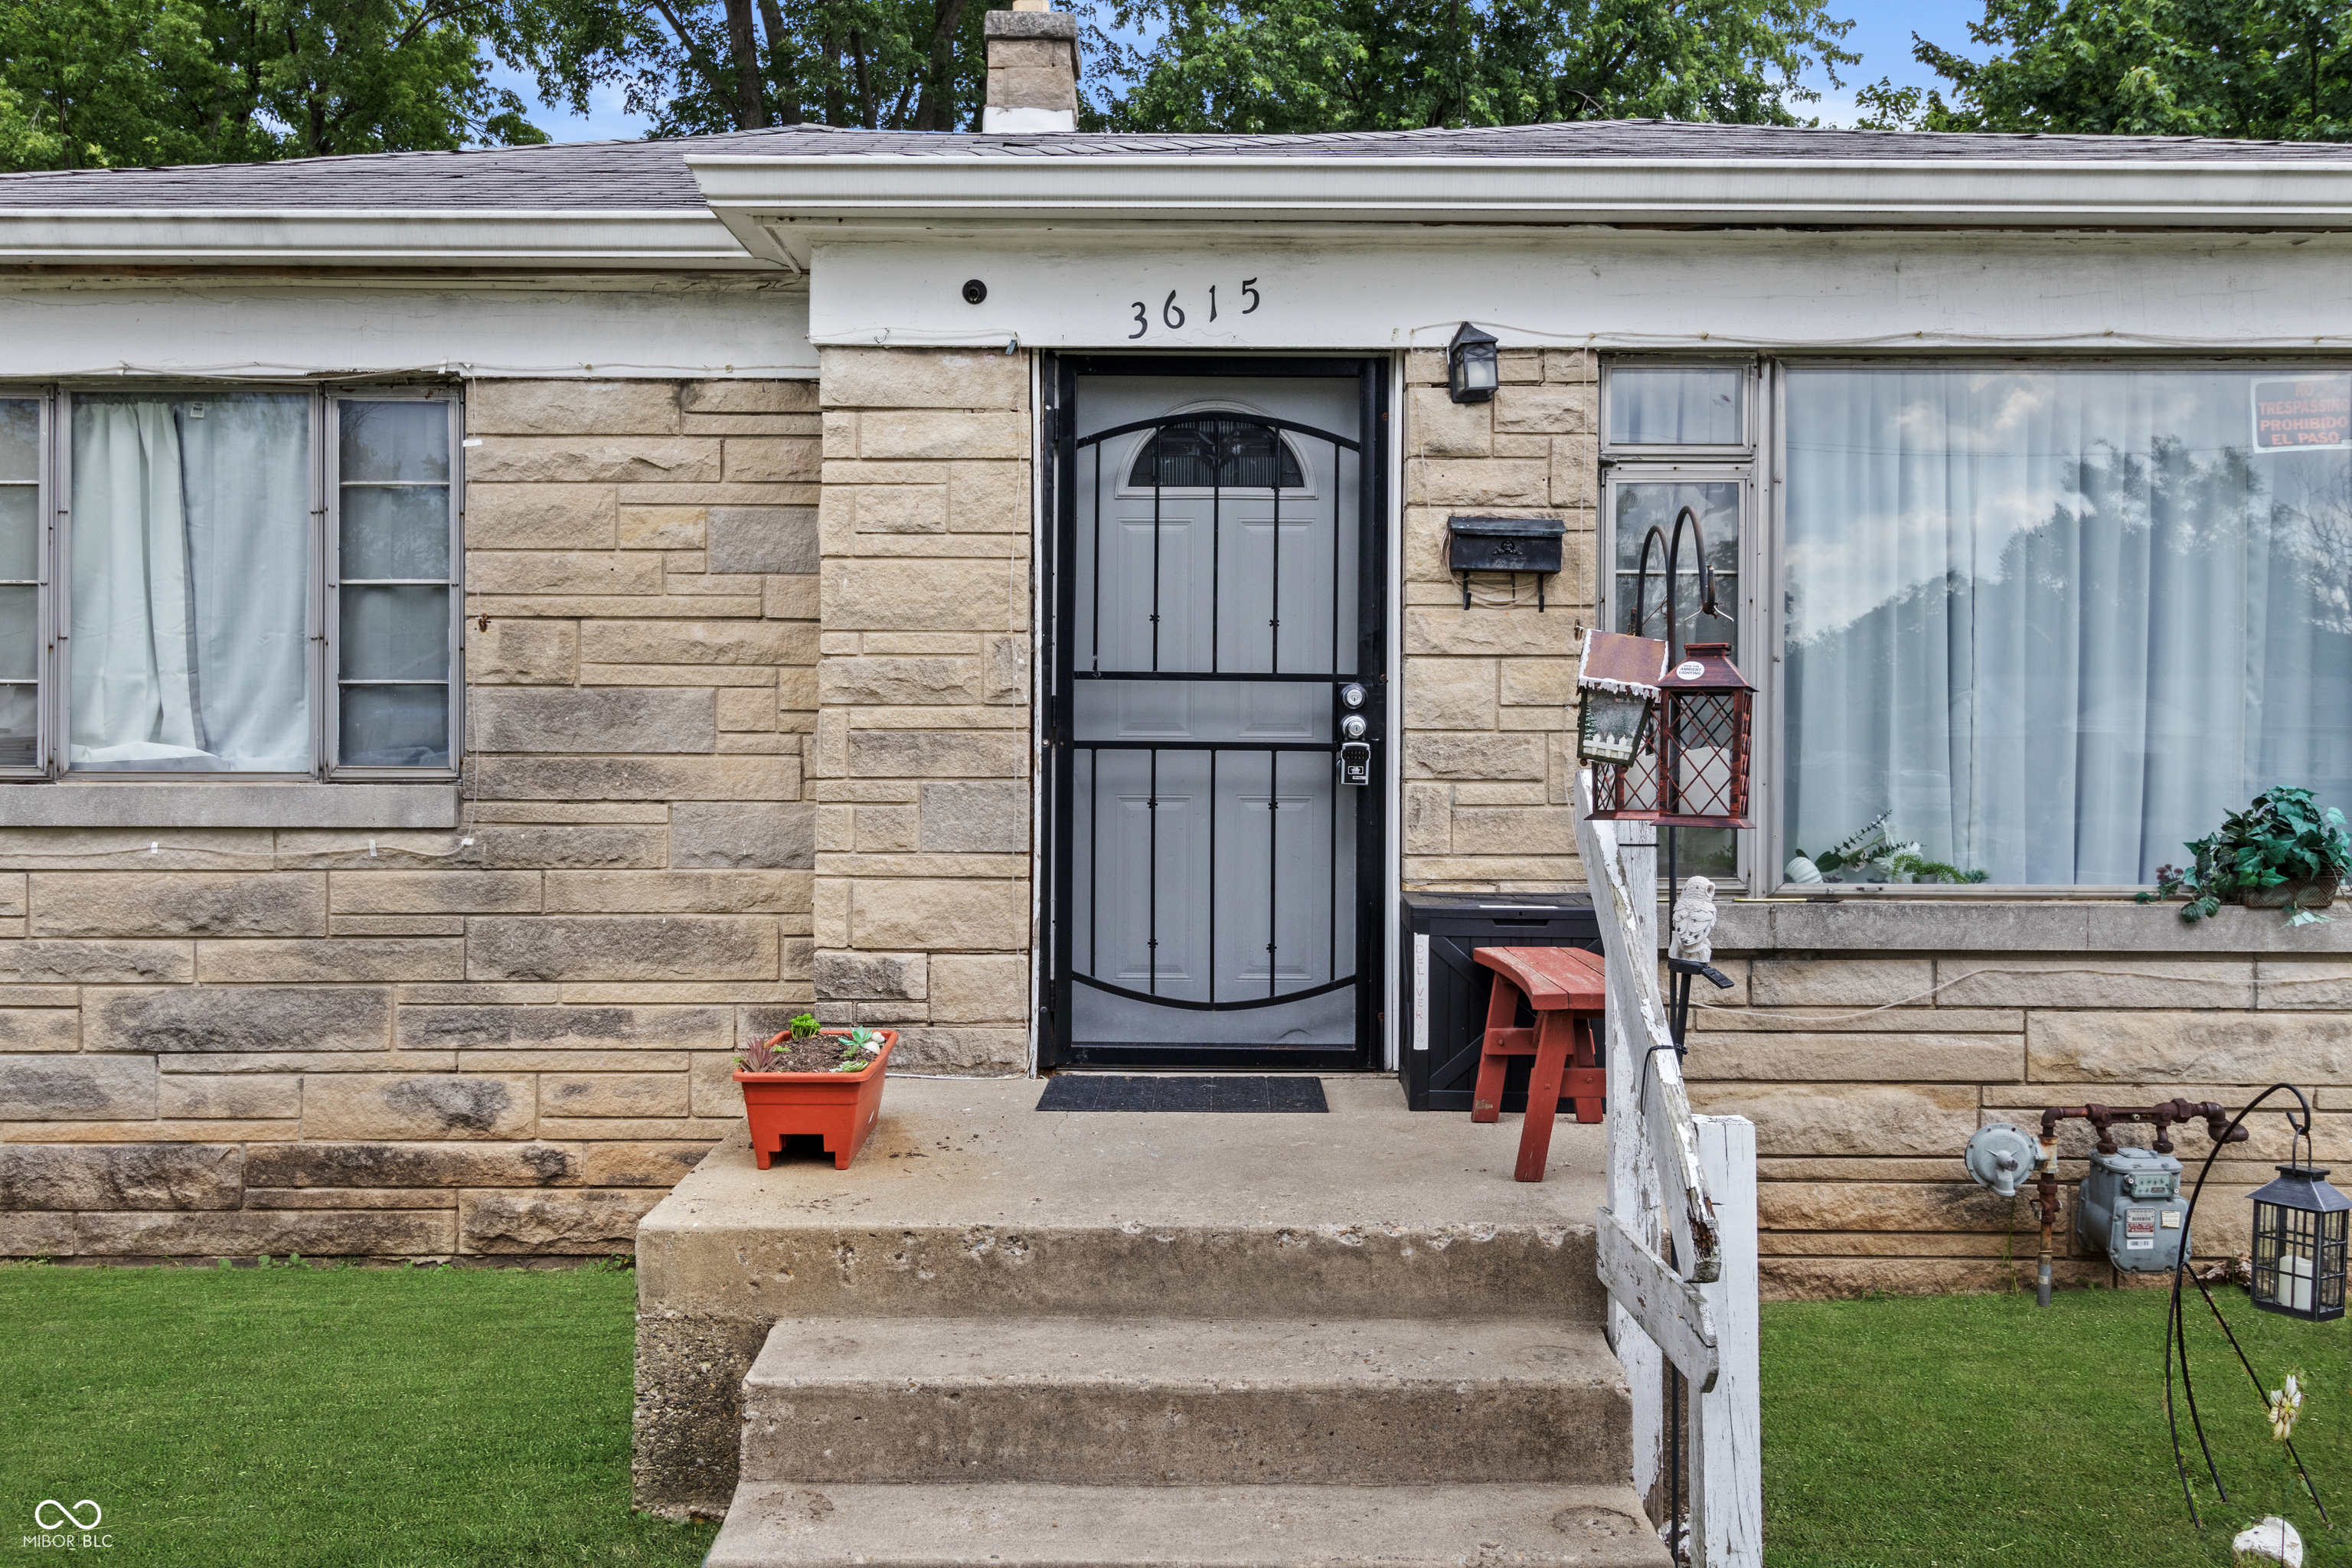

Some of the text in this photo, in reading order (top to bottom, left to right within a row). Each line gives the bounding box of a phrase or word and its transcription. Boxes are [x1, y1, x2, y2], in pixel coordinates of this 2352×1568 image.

[1128, 276, 1260, 339] 3615
[2295, 383, 2314, 397] NO
[2258, 398, 2350, 416] TRESPASSING
[2259, 416, 2350, 432] PROHIBIDO
[2271, 431, 2340, 446] EL PASO
[1416, 944, 1425, 1034] DELIVERY
